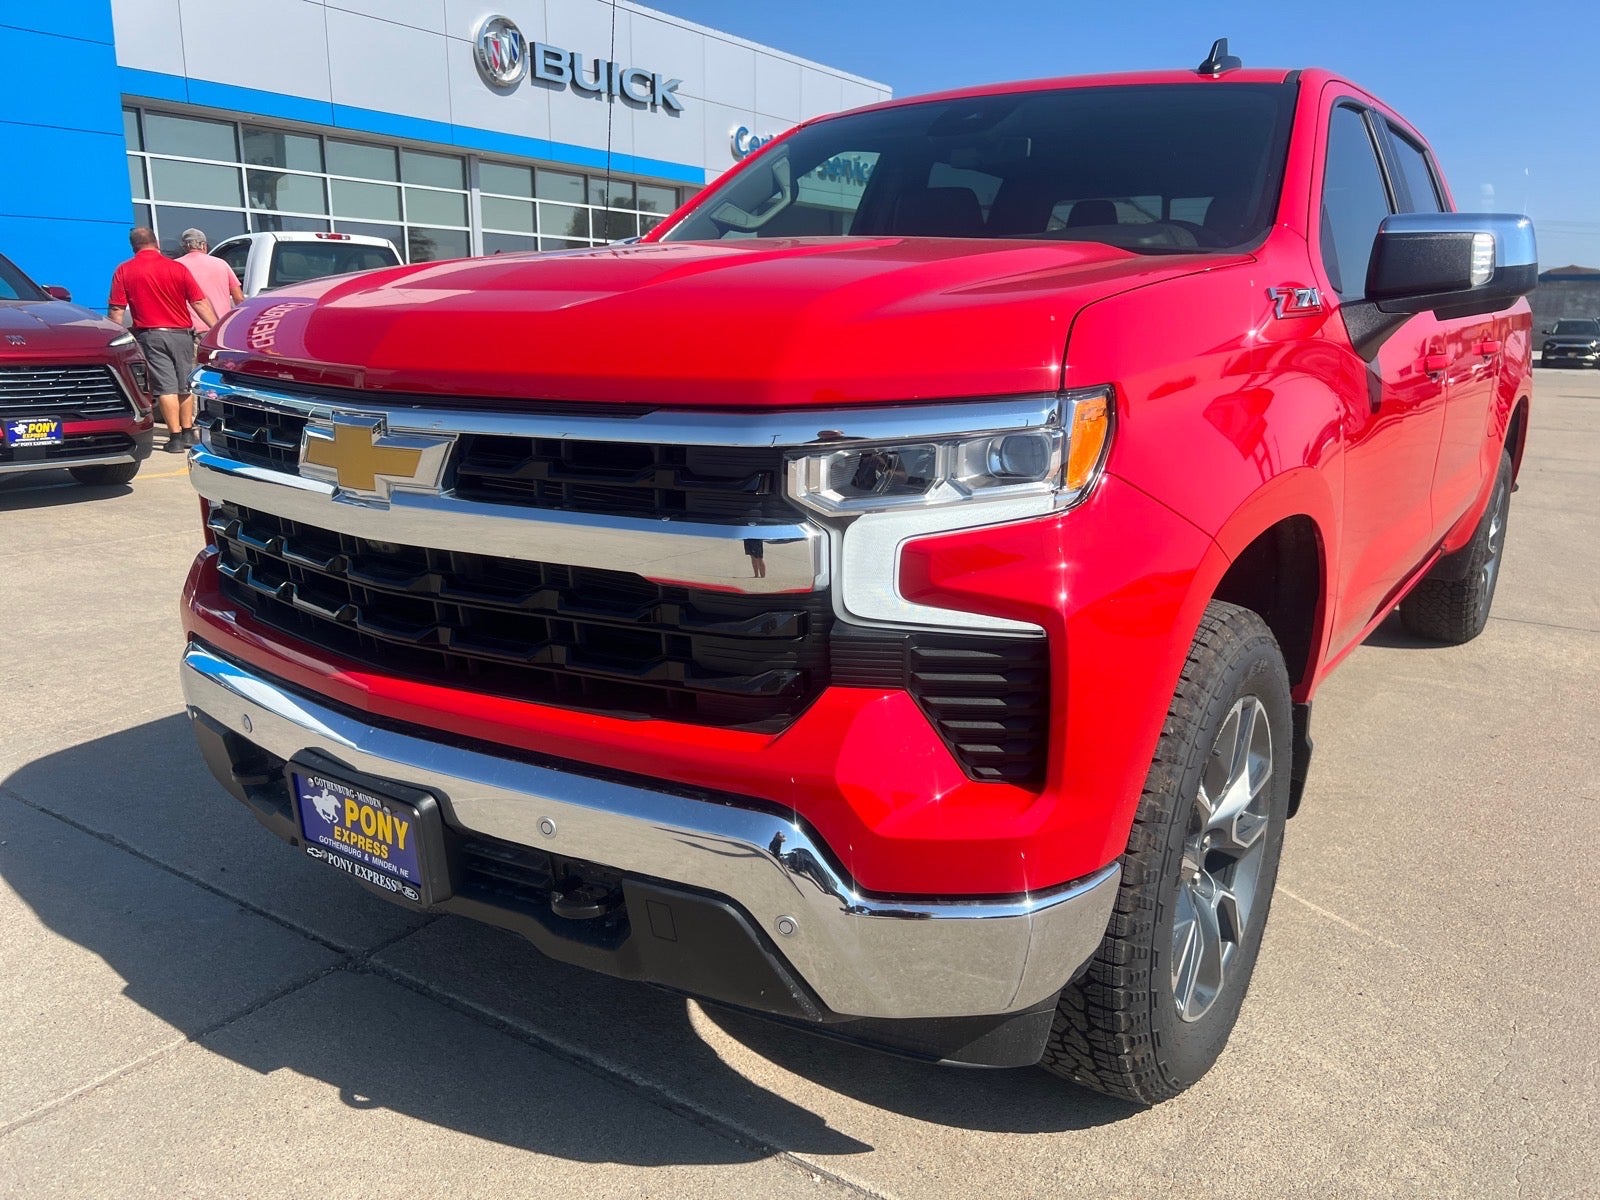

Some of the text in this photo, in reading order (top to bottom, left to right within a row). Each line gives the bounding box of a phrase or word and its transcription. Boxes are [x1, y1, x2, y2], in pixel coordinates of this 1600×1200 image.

[530, 41, 685, 111] BUICK
[1266, 287, 1322, 319] Z71
[28, 422, 57, 433] PONY
[334, 825, 389, 859] EXPRESS
[345, 798, 409, 850] PONY
[319, 835, 362, 858] GOTHENBURG
[364, 853, 369, 861] &
[400, 867, 409, 878] NE
[328, 852, 397, 893] PONY EXPRESS
